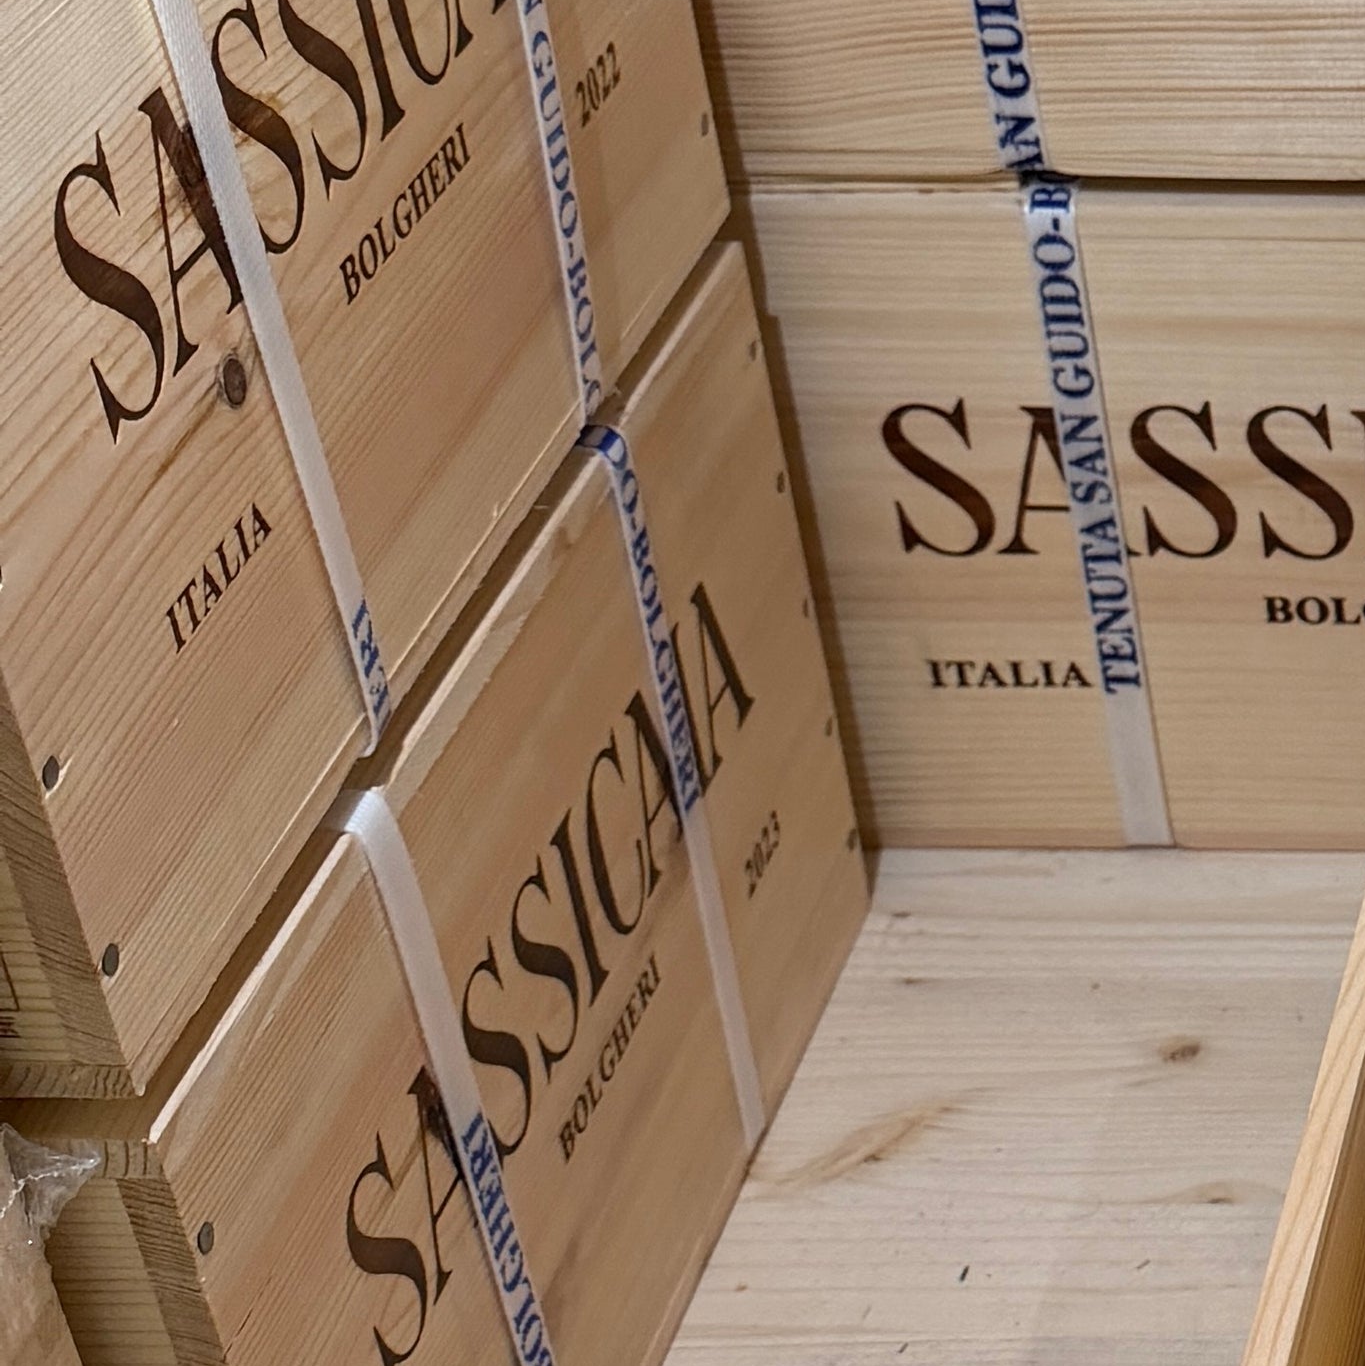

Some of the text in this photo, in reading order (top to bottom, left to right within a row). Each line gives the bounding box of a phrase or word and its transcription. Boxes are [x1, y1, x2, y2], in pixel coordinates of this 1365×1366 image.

[574, 40, 623, 131] 2022
[338, 121, 472, 306] BOLGHERI
[1061, 412, 1115, 506] SAN
[163, 501, 274, 654] ITALIA
[1077, 512, 1142, 694] TENUTA
[929, 658, 1093, 689] ITALIA
[558, 953, 663, 1165] BOLGHERI
